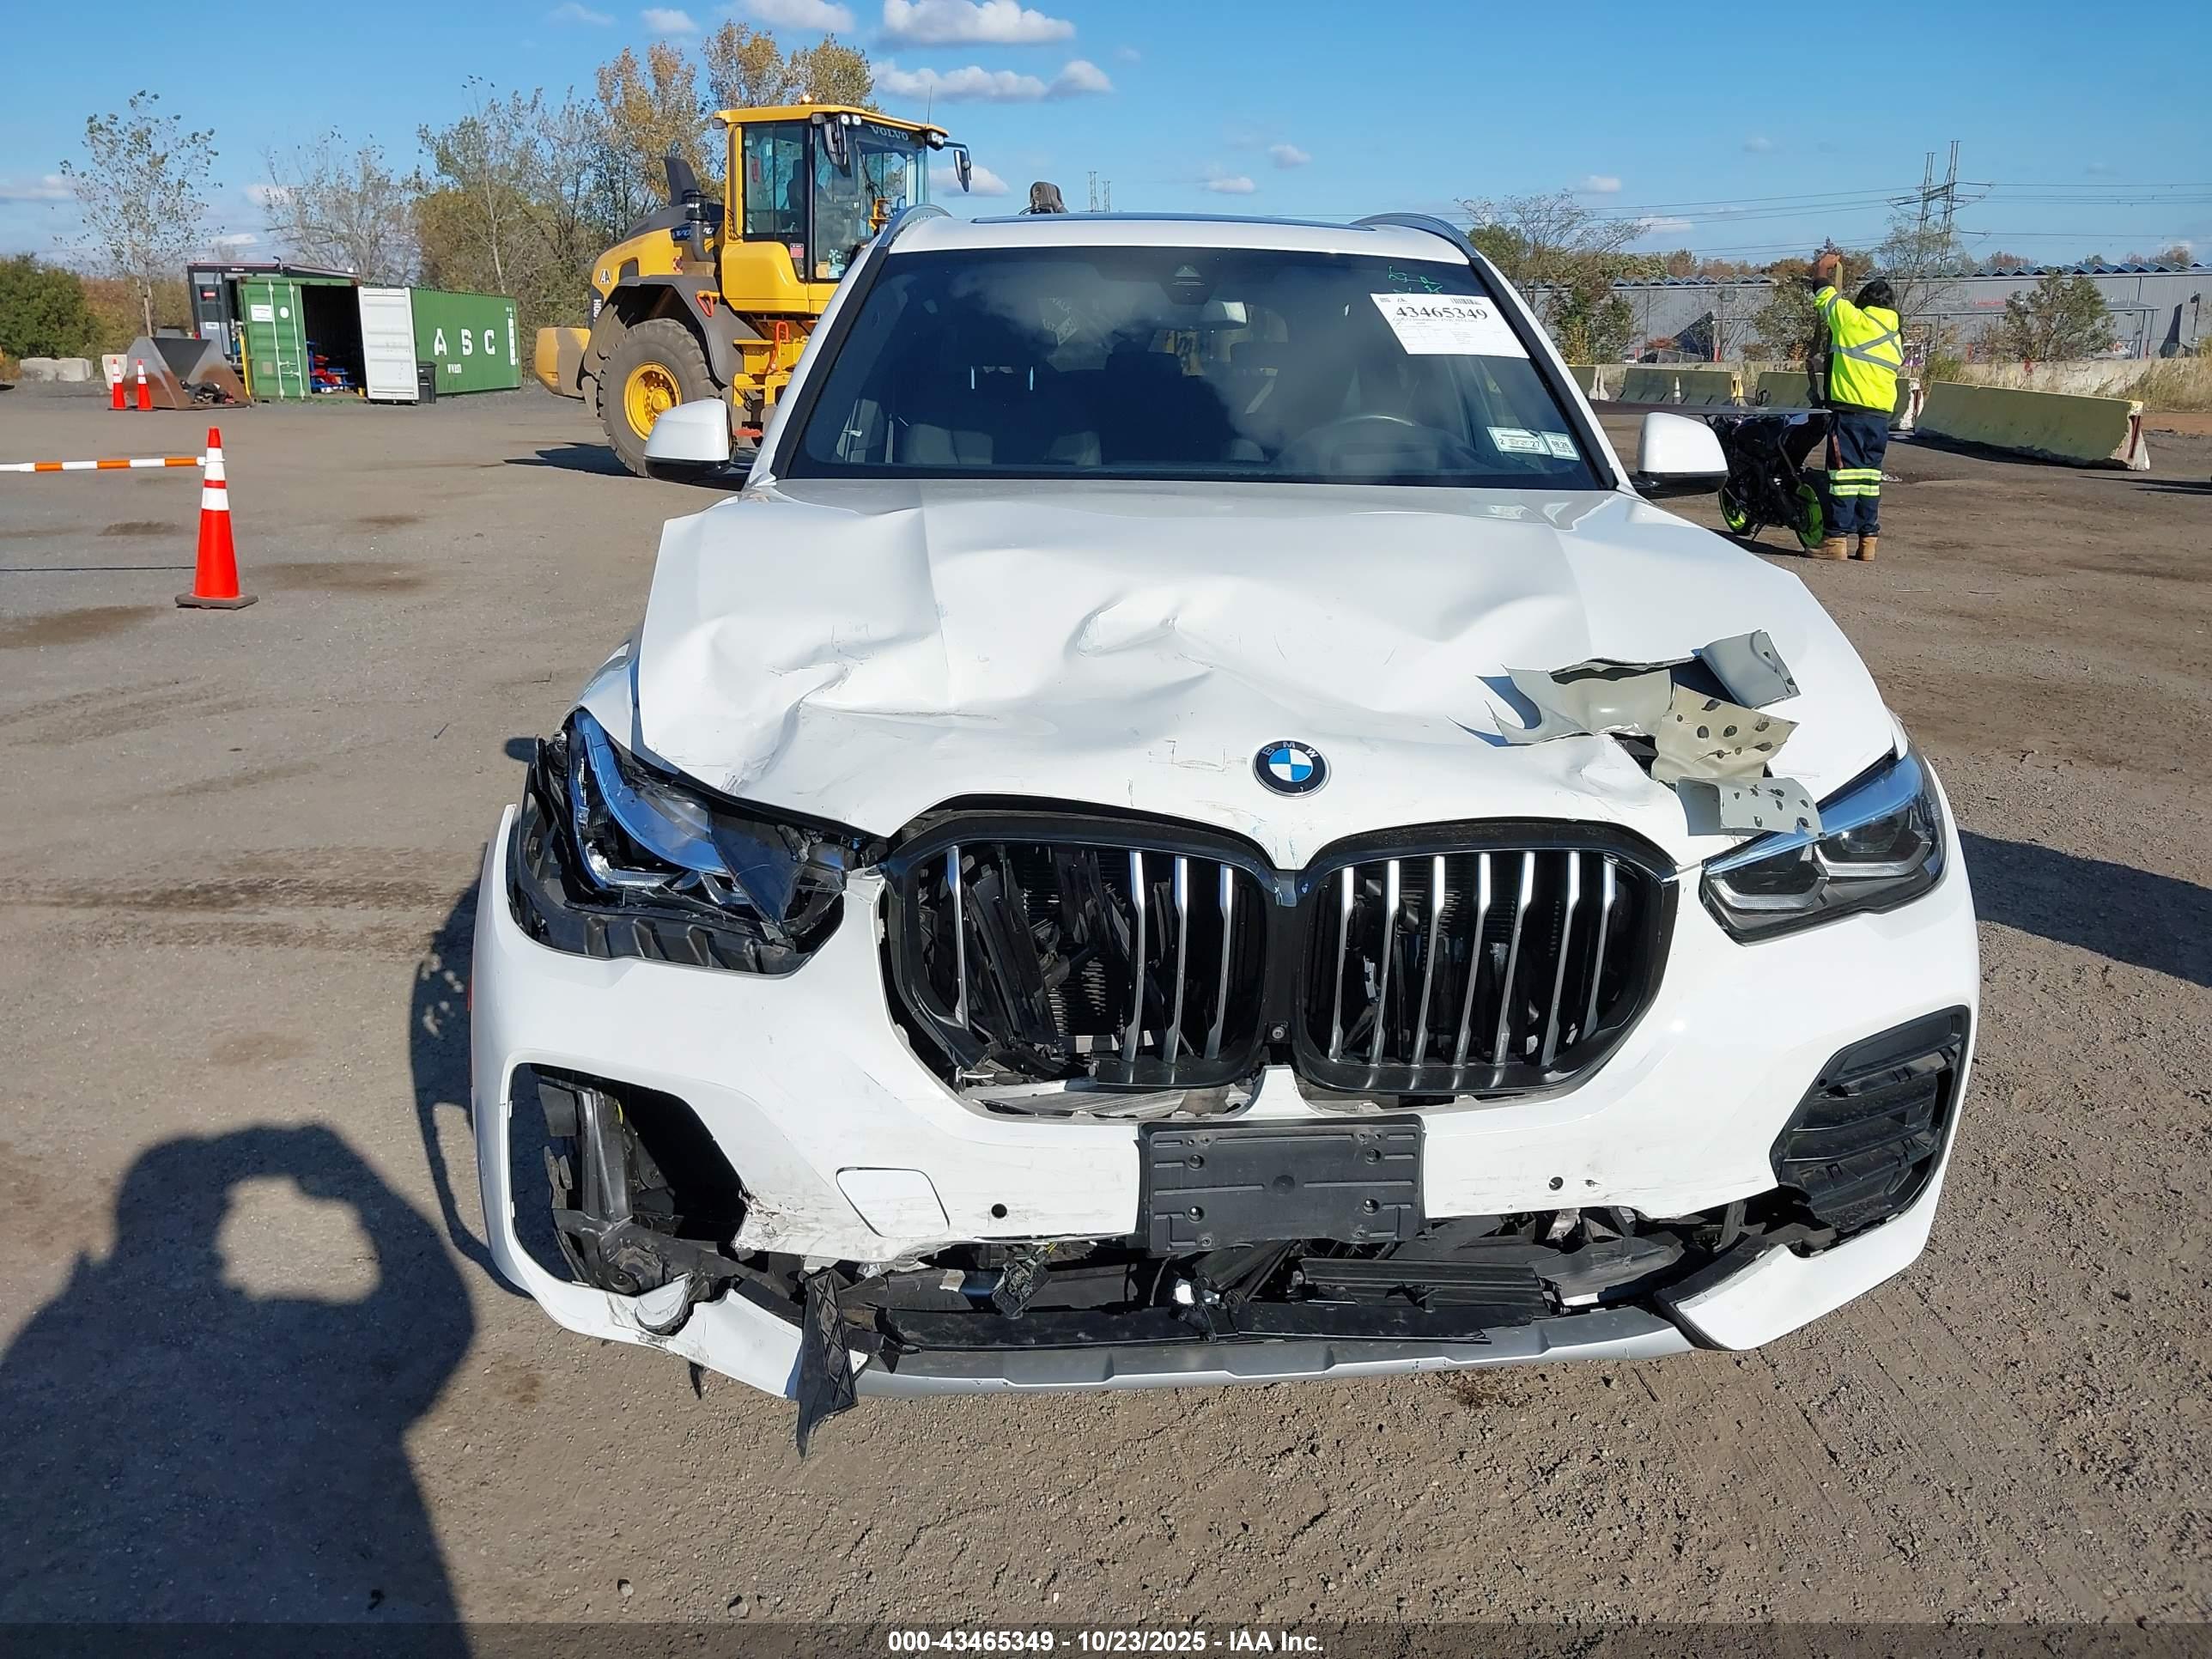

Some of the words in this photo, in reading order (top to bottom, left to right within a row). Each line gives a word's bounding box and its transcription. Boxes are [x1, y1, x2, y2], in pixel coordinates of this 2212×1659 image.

[869, 125, 908, 141] VOLVO
[1396, 307, 1488, 320] 43465349
[1261, 742, 1319, 758] BMW
